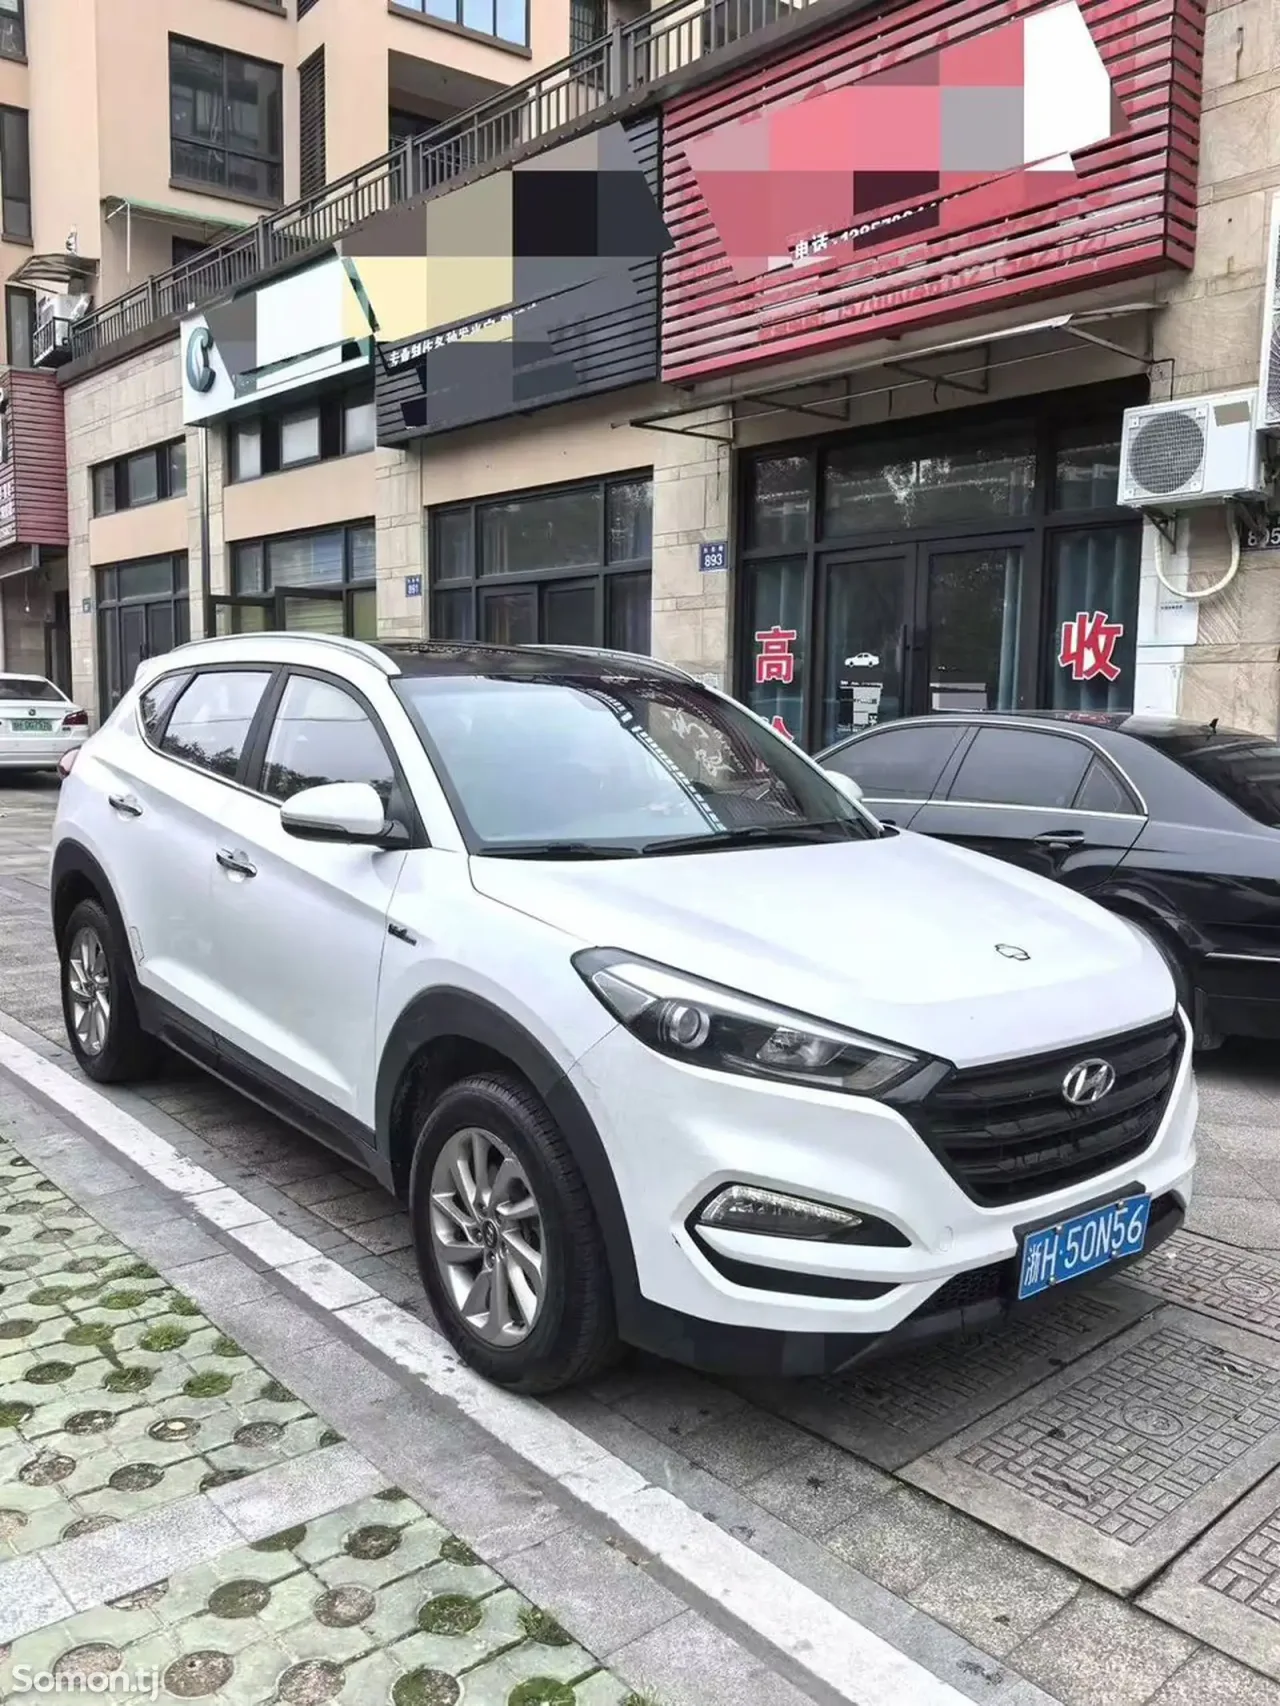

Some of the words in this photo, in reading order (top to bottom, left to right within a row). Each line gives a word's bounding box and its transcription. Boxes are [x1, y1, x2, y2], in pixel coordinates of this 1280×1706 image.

[704, 553, 723, 567] 893
[755, 625, 797, 684] 高
[1057, 610, 1124, 682] 收
